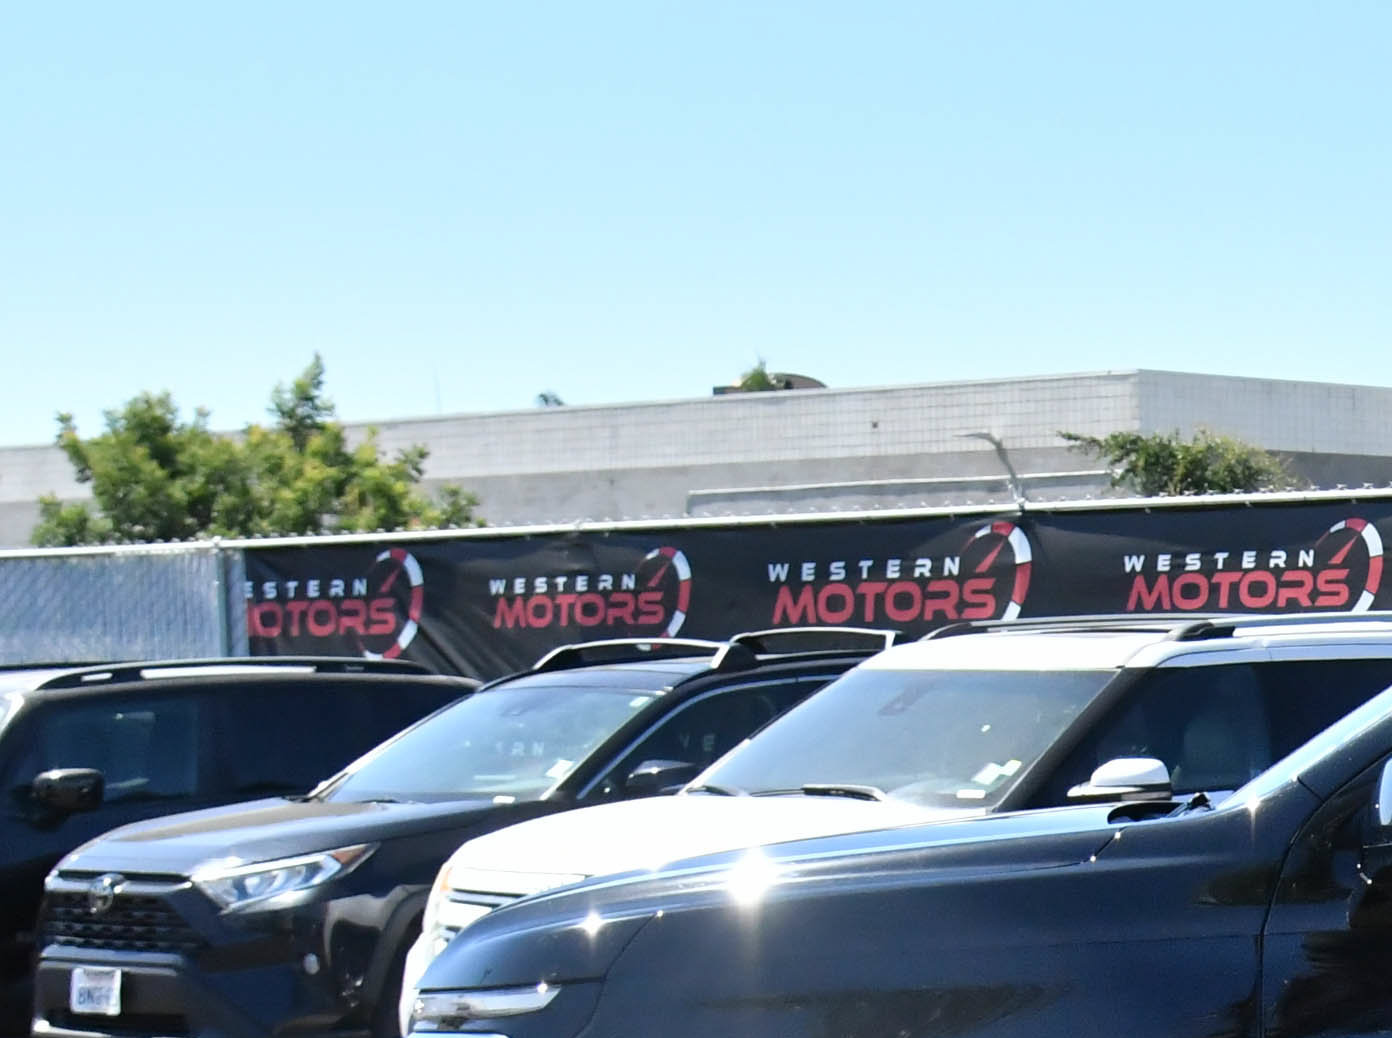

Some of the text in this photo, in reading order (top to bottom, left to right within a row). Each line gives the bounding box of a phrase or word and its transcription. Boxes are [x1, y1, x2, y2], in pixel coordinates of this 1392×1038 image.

[768, 555, 961, 583] WESTERN
[1123, 548, 1315, 573] WESTERN
[489, 573, 637, 596] WESTERN
[771, 577, 997, 626] MOTORS
[1125, 568, 1350, 612] MOTORS
[246, 597, 397, 638] OTORS
[493, 591, 666, 630] MOTORS
